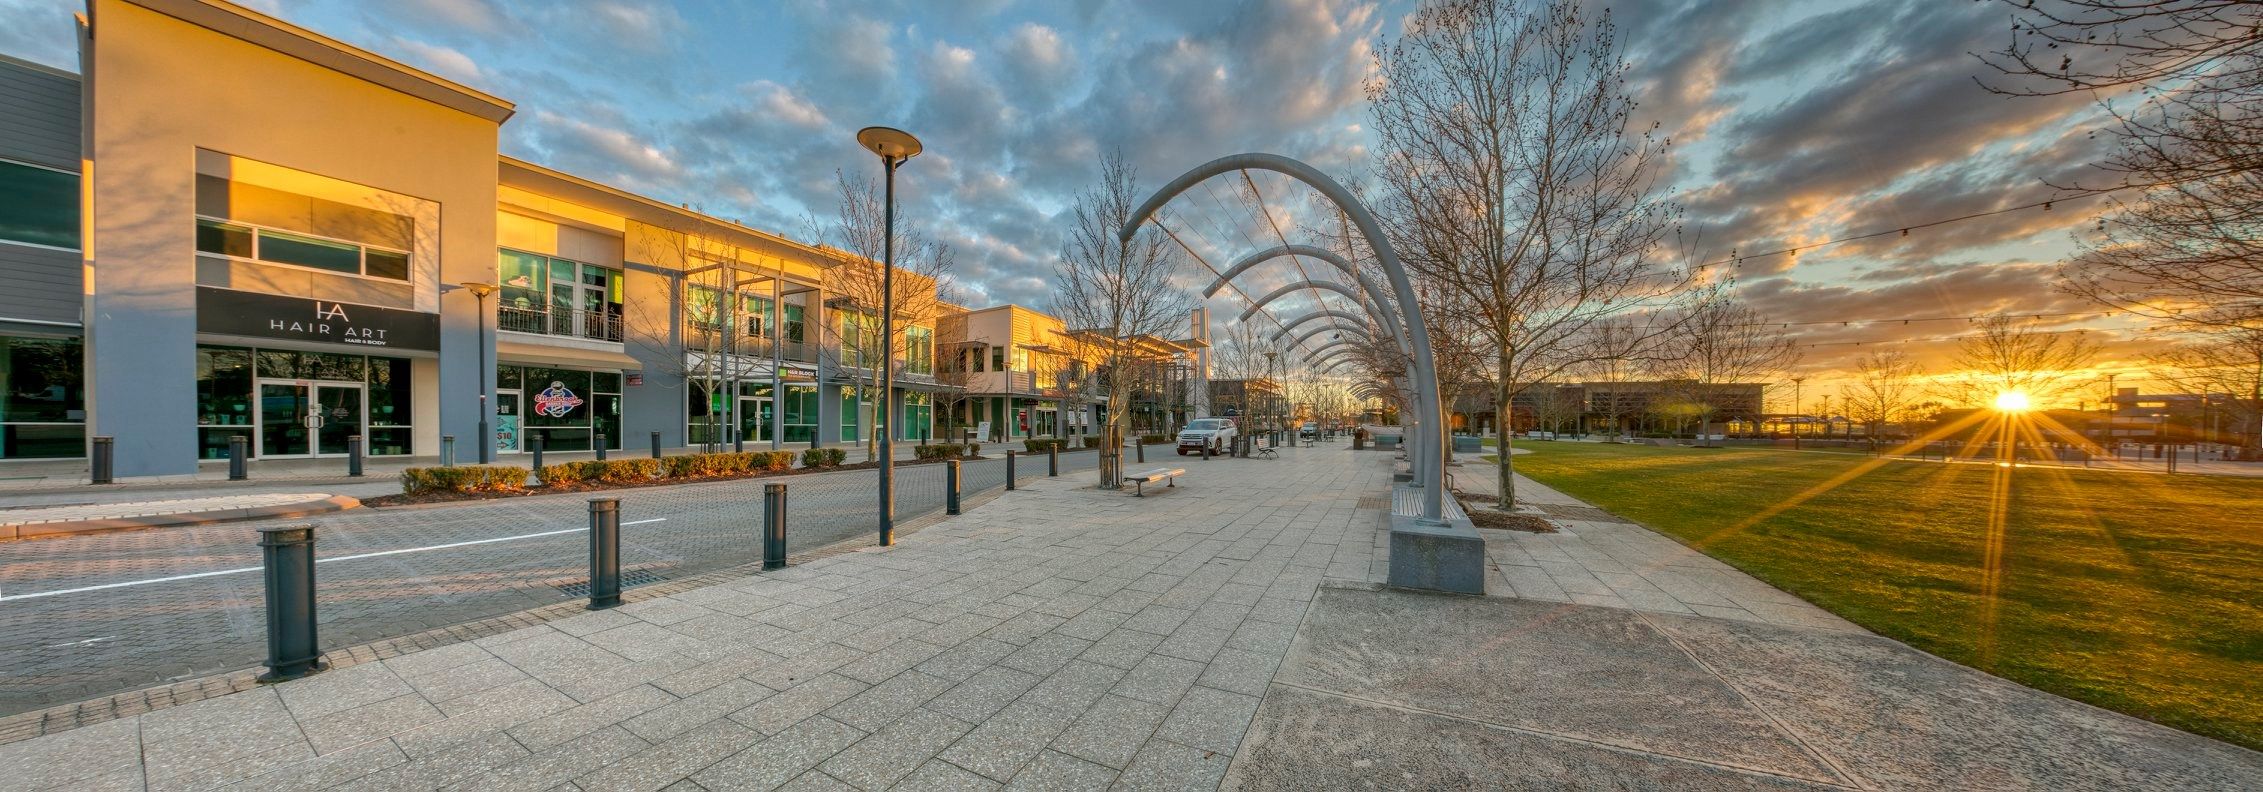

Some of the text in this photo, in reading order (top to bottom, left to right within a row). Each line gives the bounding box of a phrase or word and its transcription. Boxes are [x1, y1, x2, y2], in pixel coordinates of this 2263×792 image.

[316, 301, 349, 322] HA
[270, 319, 388, 339] HAIR ART
[497, 431, 512, 440] $10
